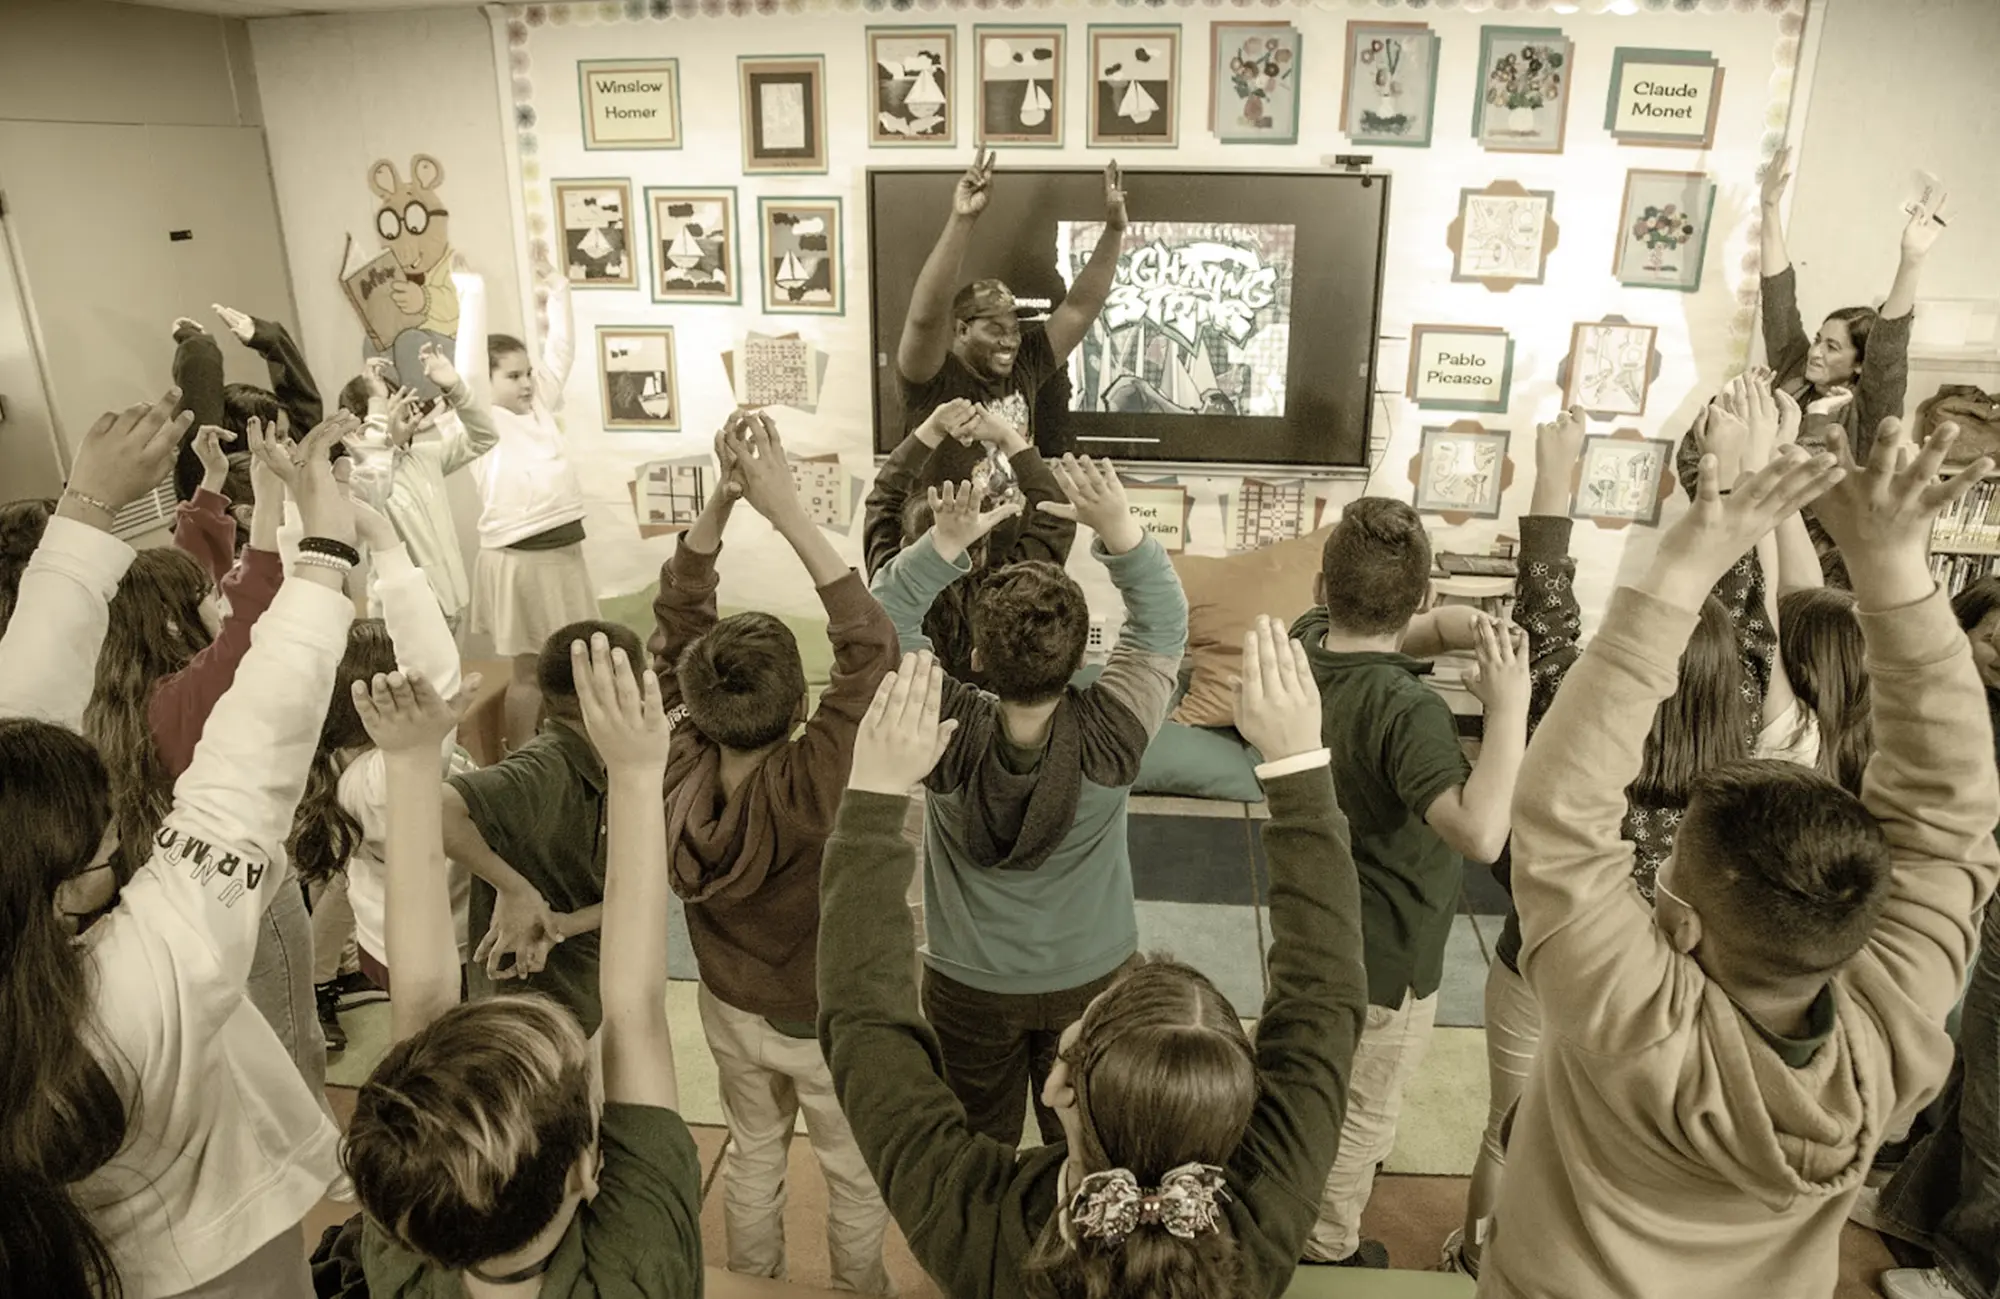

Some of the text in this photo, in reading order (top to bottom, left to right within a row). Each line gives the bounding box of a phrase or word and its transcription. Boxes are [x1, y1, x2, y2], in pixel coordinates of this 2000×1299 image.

[596, 80, 662, 93] Winslow
[1633, 81, 1698, 98] Claude
[605, 105, 657, 119] Homer
[1631, 102, 1692, 118] Monet
[1438, 352, 1486, 367] Pablo
[1427, 370, 1493, 386] Picasso
[1129, 506, 1157, 518] Piet
[1145, 522, 1179, 533] drian
